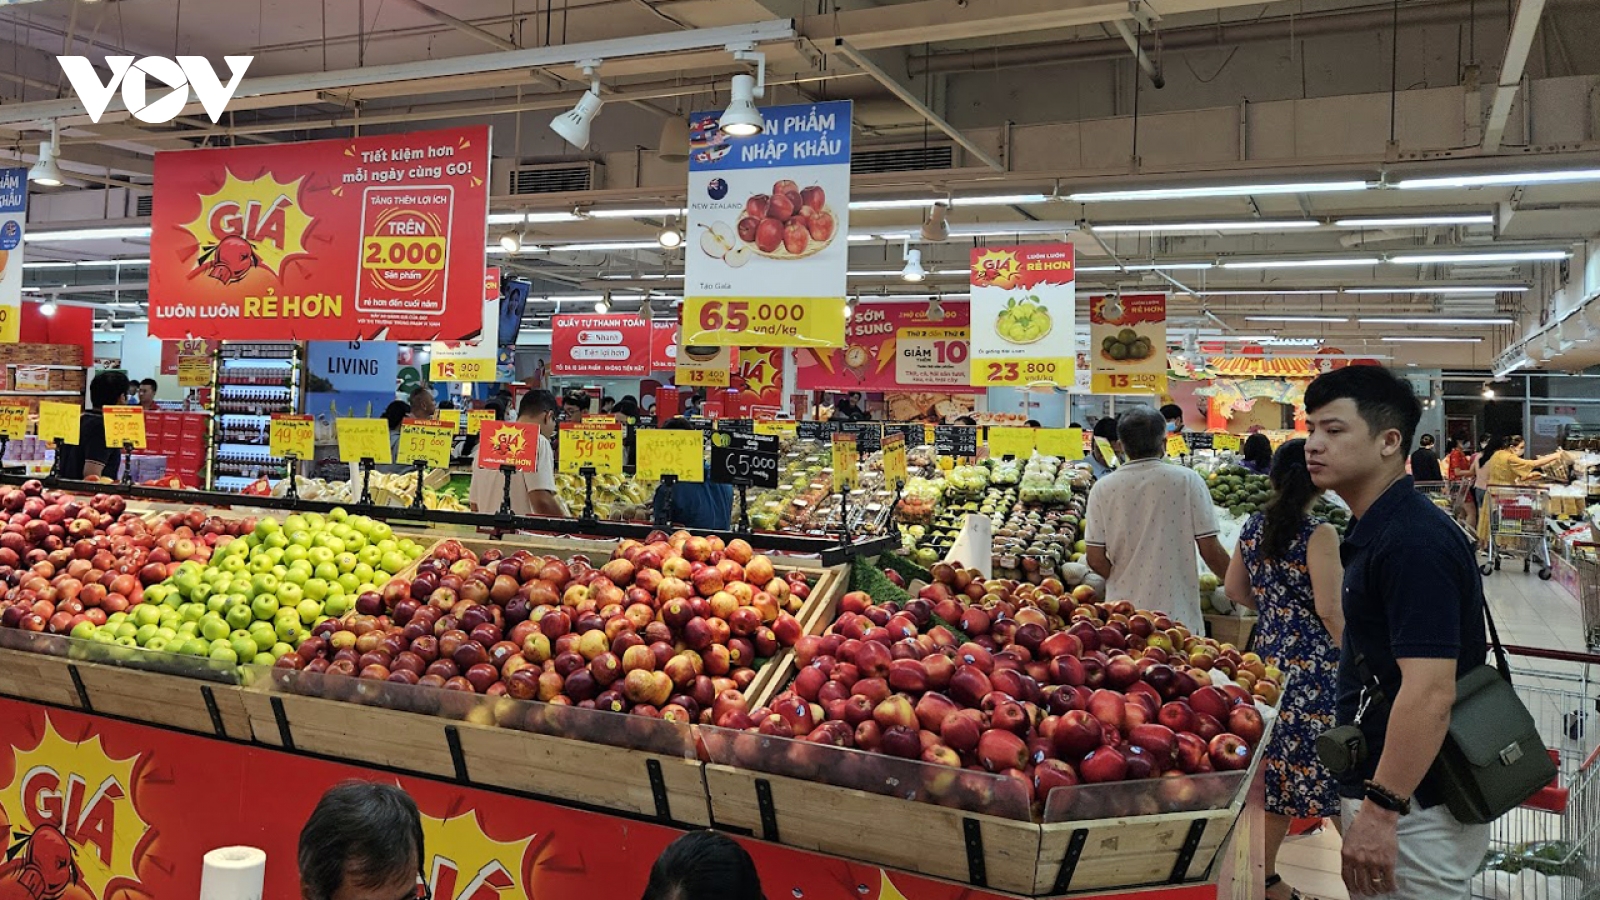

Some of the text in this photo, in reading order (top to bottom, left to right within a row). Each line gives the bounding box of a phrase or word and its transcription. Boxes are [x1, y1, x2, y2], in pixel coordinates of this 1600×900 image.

[784, 106, 835, 134] PHẨM
[361, 145, 454, 163] Tiết kiệm hơn
[742, 131, 841, 164] NHẬP KHẨU
[343, 162, 472, 183] mỗi ngày cùng GO!
[207, 193, 293, 251] GIÁ
[388, 218, 426, 235] TRÊN
[366, 242, 442, 264] 2.000
[982, 257, 1011, 271] GIÁ
[1026, 260, 1071, 271] RẺ HƠN
[156, 287, 342, 318] LUÔN LUÔN RẺ HƠN
[593, 319, 620, 327] THANH
[623, 318, 645, 327] TOÁN
[855, 308, 885, 323] SỚM
[754, 323, 797, 336] vnd/kg
[855, 322, 893, 336] SUNG
[904, 346, 931, 357] GIẢM
[328, 356, 378, 375] LIVING
[20, 765, 125, 870] GIÁ
